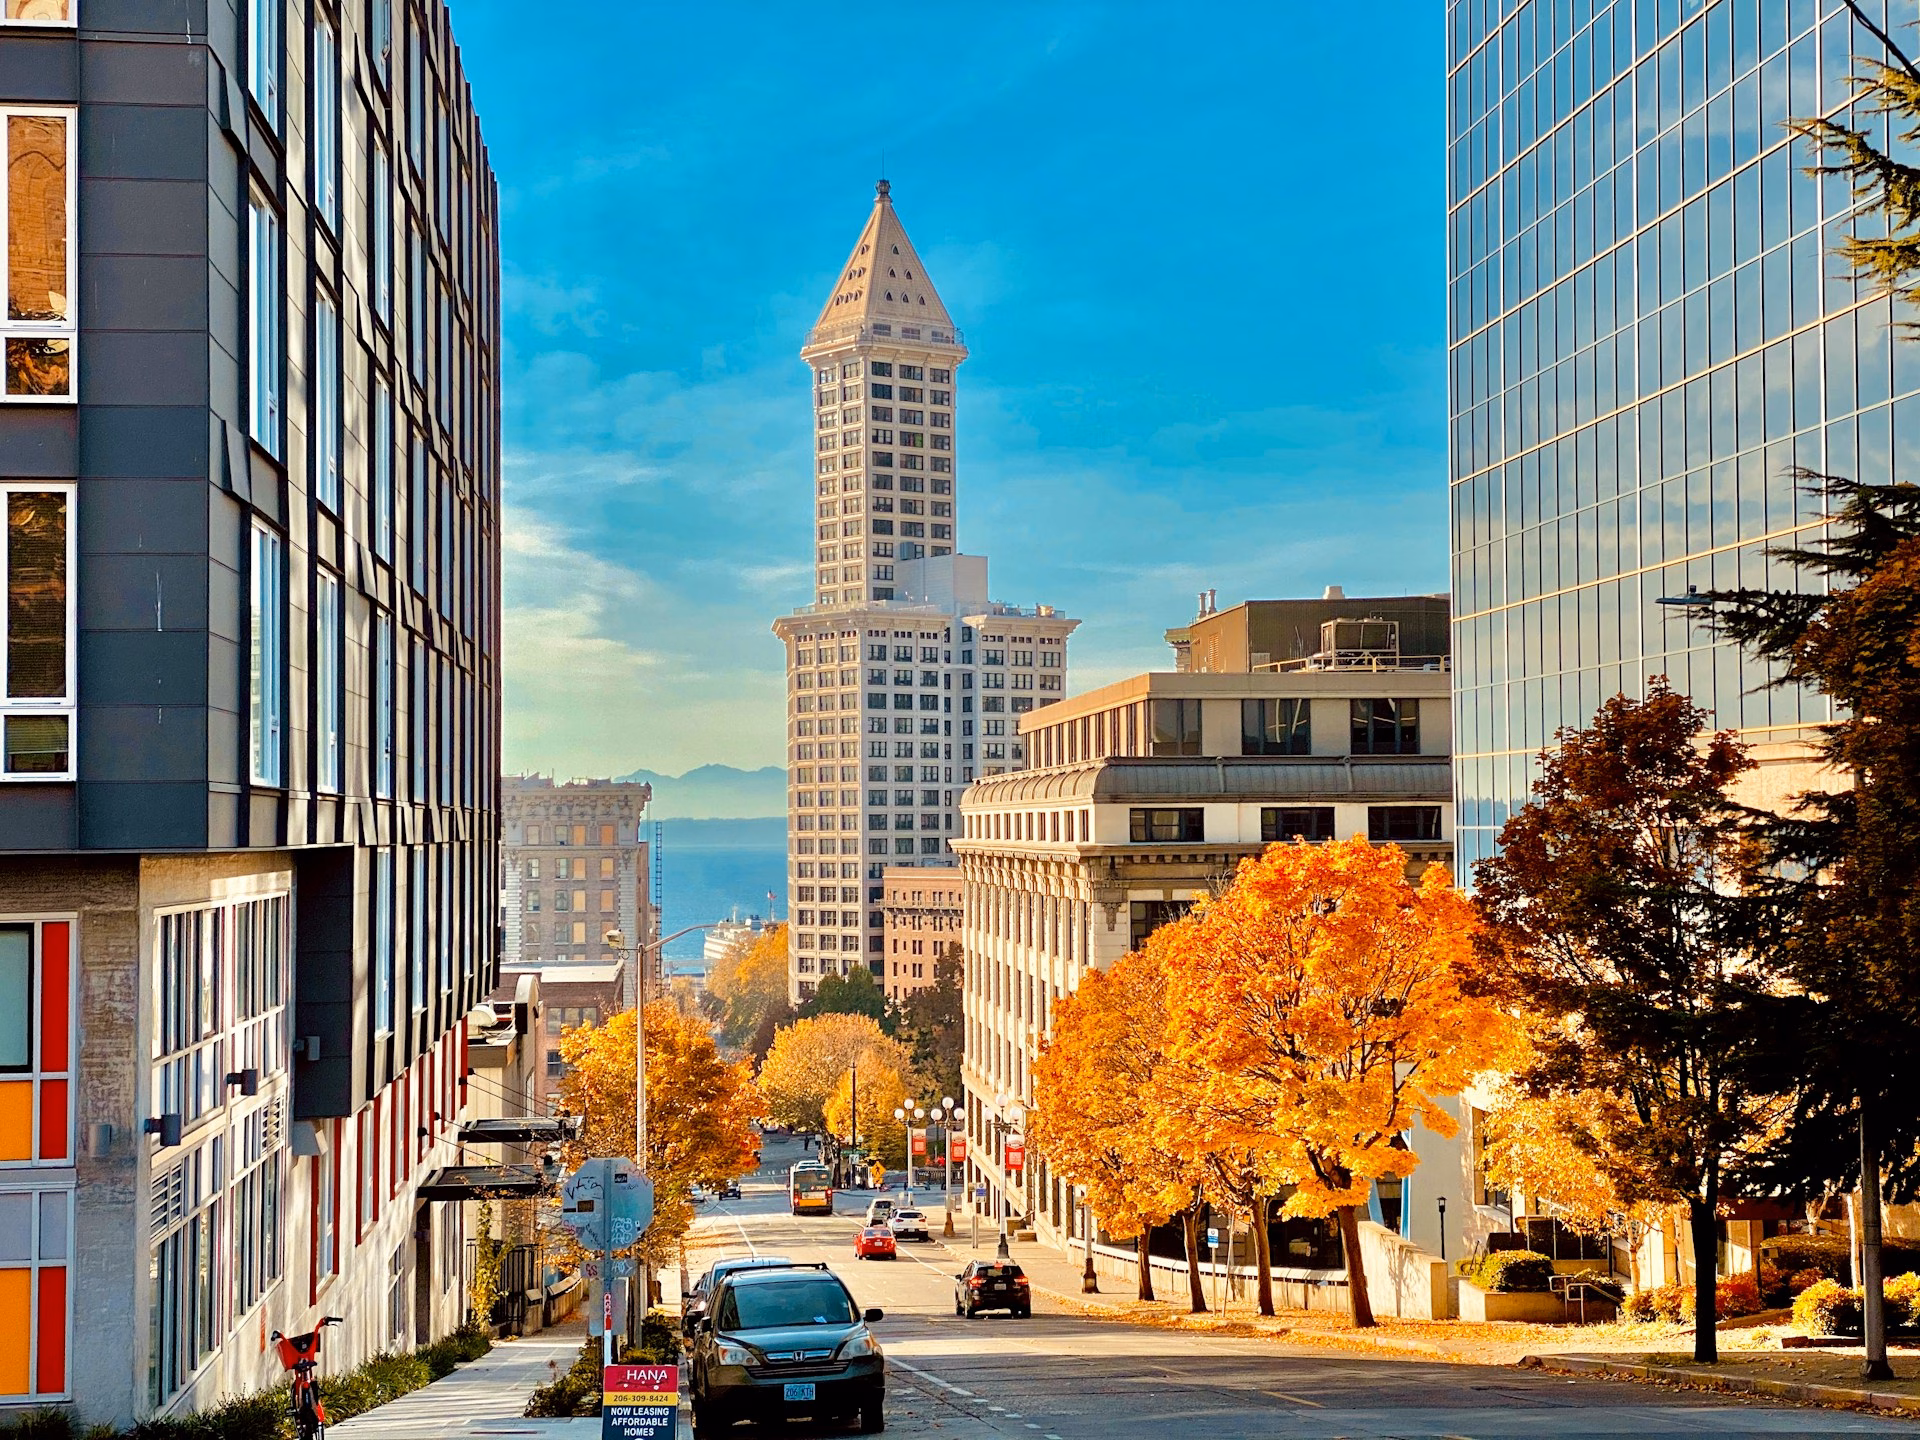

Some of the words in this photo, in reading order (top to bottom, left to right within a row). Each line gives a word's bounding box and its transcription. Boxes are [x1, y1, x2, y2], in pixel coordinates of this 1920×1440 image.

[627, 1369, 668, 1380] HANA
[613, 1394, 668, 1402] 206-309-8424
[610, 1407, 631, 1416] NOW
[633, 1407, 669, 1416] LEASING
[611, 1417, 668, 1426] AFFORDABLE
[624, 1427, 654, 1436] HOMES
